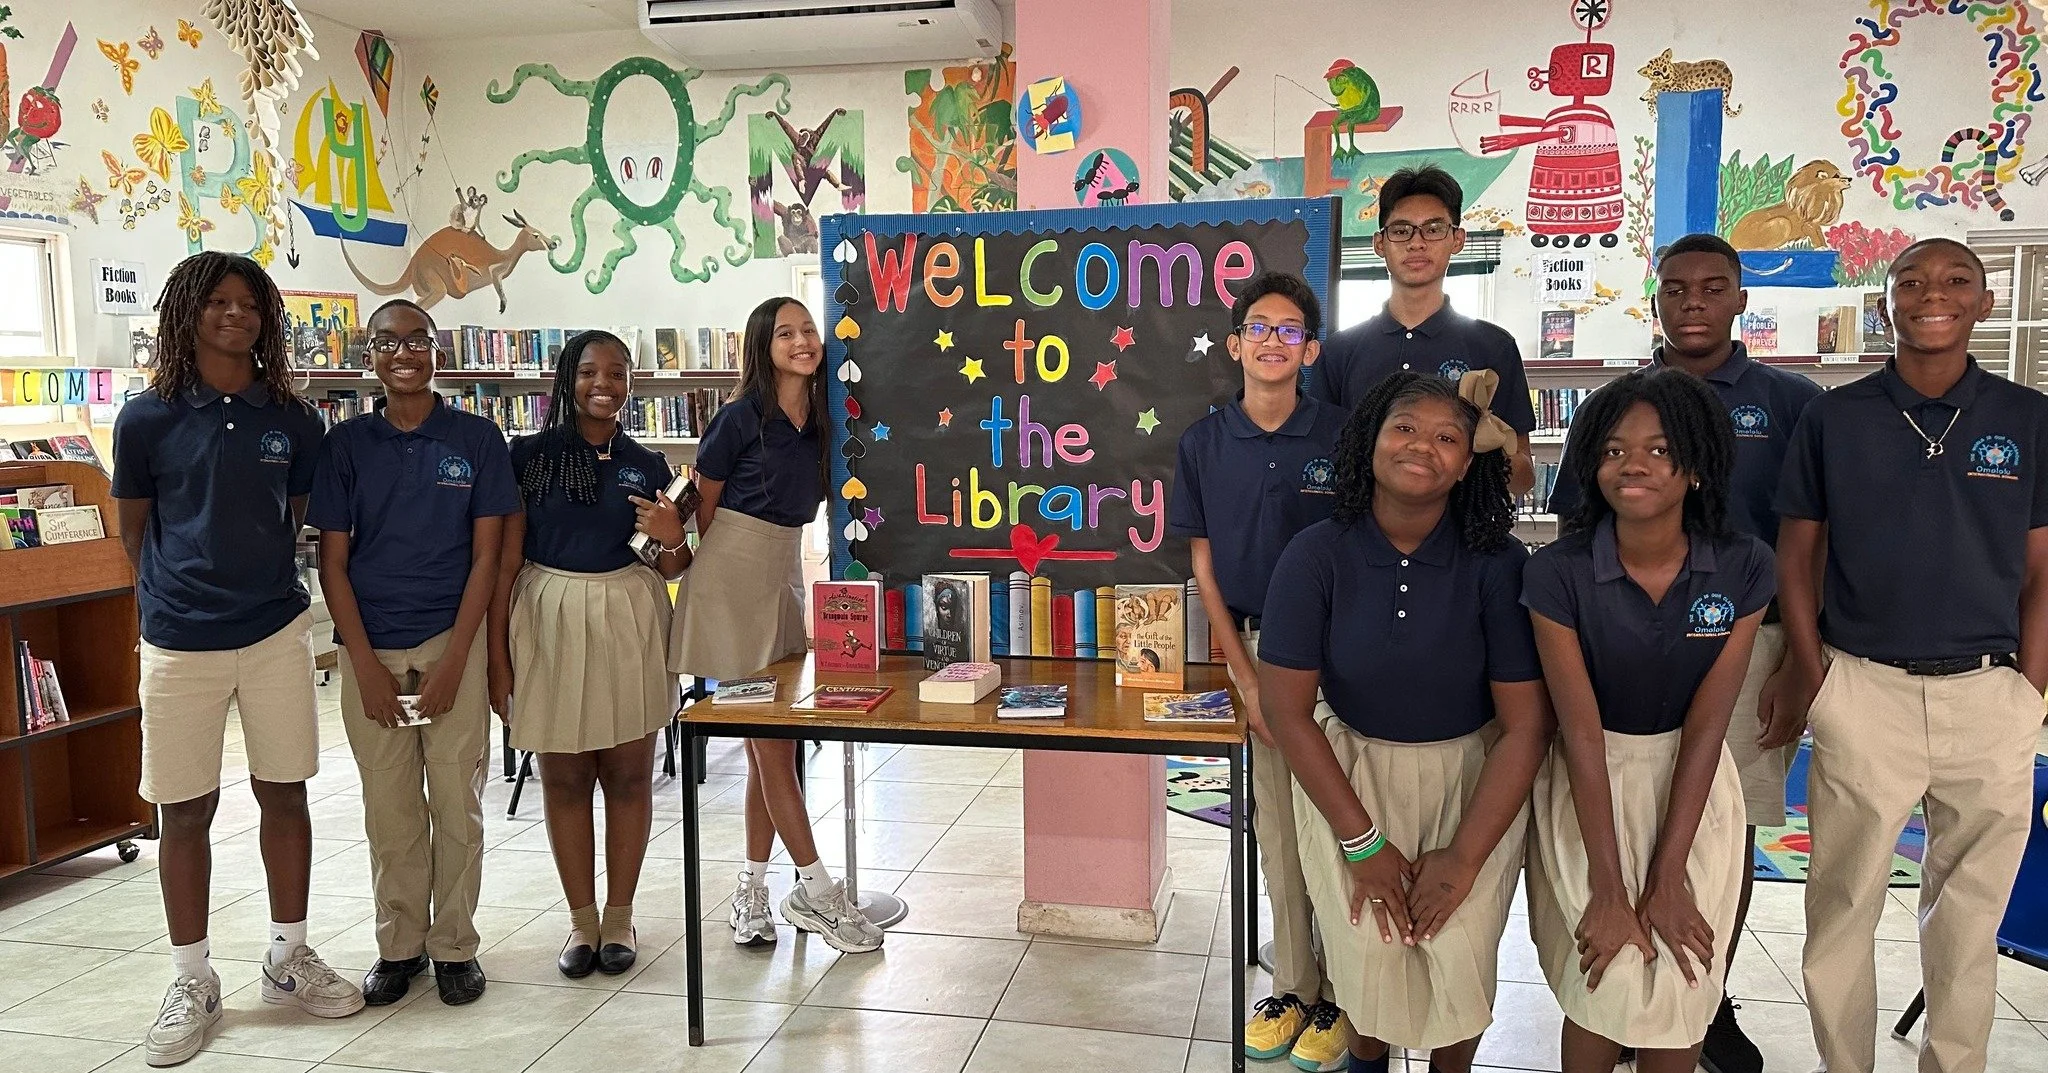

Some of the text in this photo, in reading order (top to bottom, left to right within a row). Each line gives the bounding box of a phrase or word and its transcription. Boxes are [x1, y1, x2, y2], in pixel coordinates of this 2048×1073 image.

[1586, 55, 1602, 76] R
[1, 187, 54, 202] VEGETABLES
[102, 266, 136, 283] Fiction
[105, 288, 137, 303] Books
[1747, 320, 1777, 330] PROBLEM
[1002, 318, 1070, 384] to
[980, 395, 1096, 468] the
[914, 463, 1165, 553] Library
[928, 627, 962, 642] CHILDREN
[1145, 632, 1158, 641] Gift
[1694, 625, 1727, 633] Omololu
[933, 643, 958, 657] VIRTUE
[1134, 640, 1176, 651] Little People
[925, 658, 948, 670] VENGE
